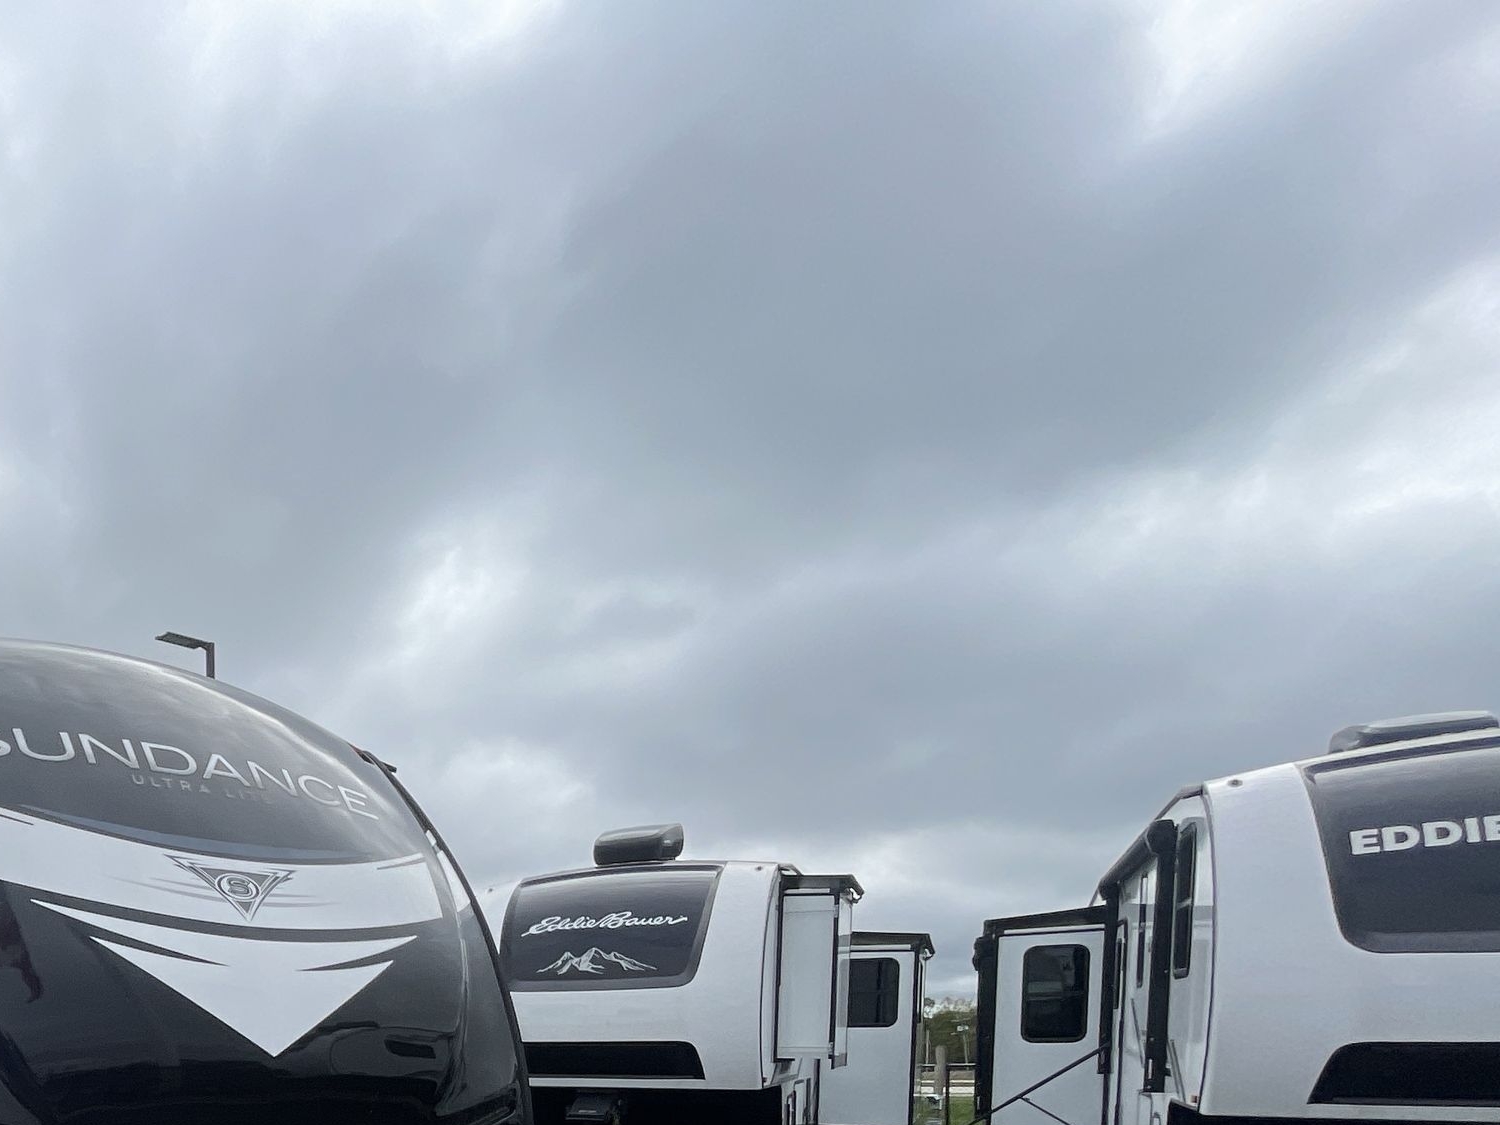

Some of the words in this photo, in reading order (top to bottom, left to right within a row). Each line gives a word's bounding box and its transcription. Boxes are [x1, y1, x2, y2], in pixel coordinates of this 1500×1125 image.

[131, 774, 212, 794] ULTRA
[521, 916, 601, 937] Eddie
[599, 911, 688, 929] Bauer
